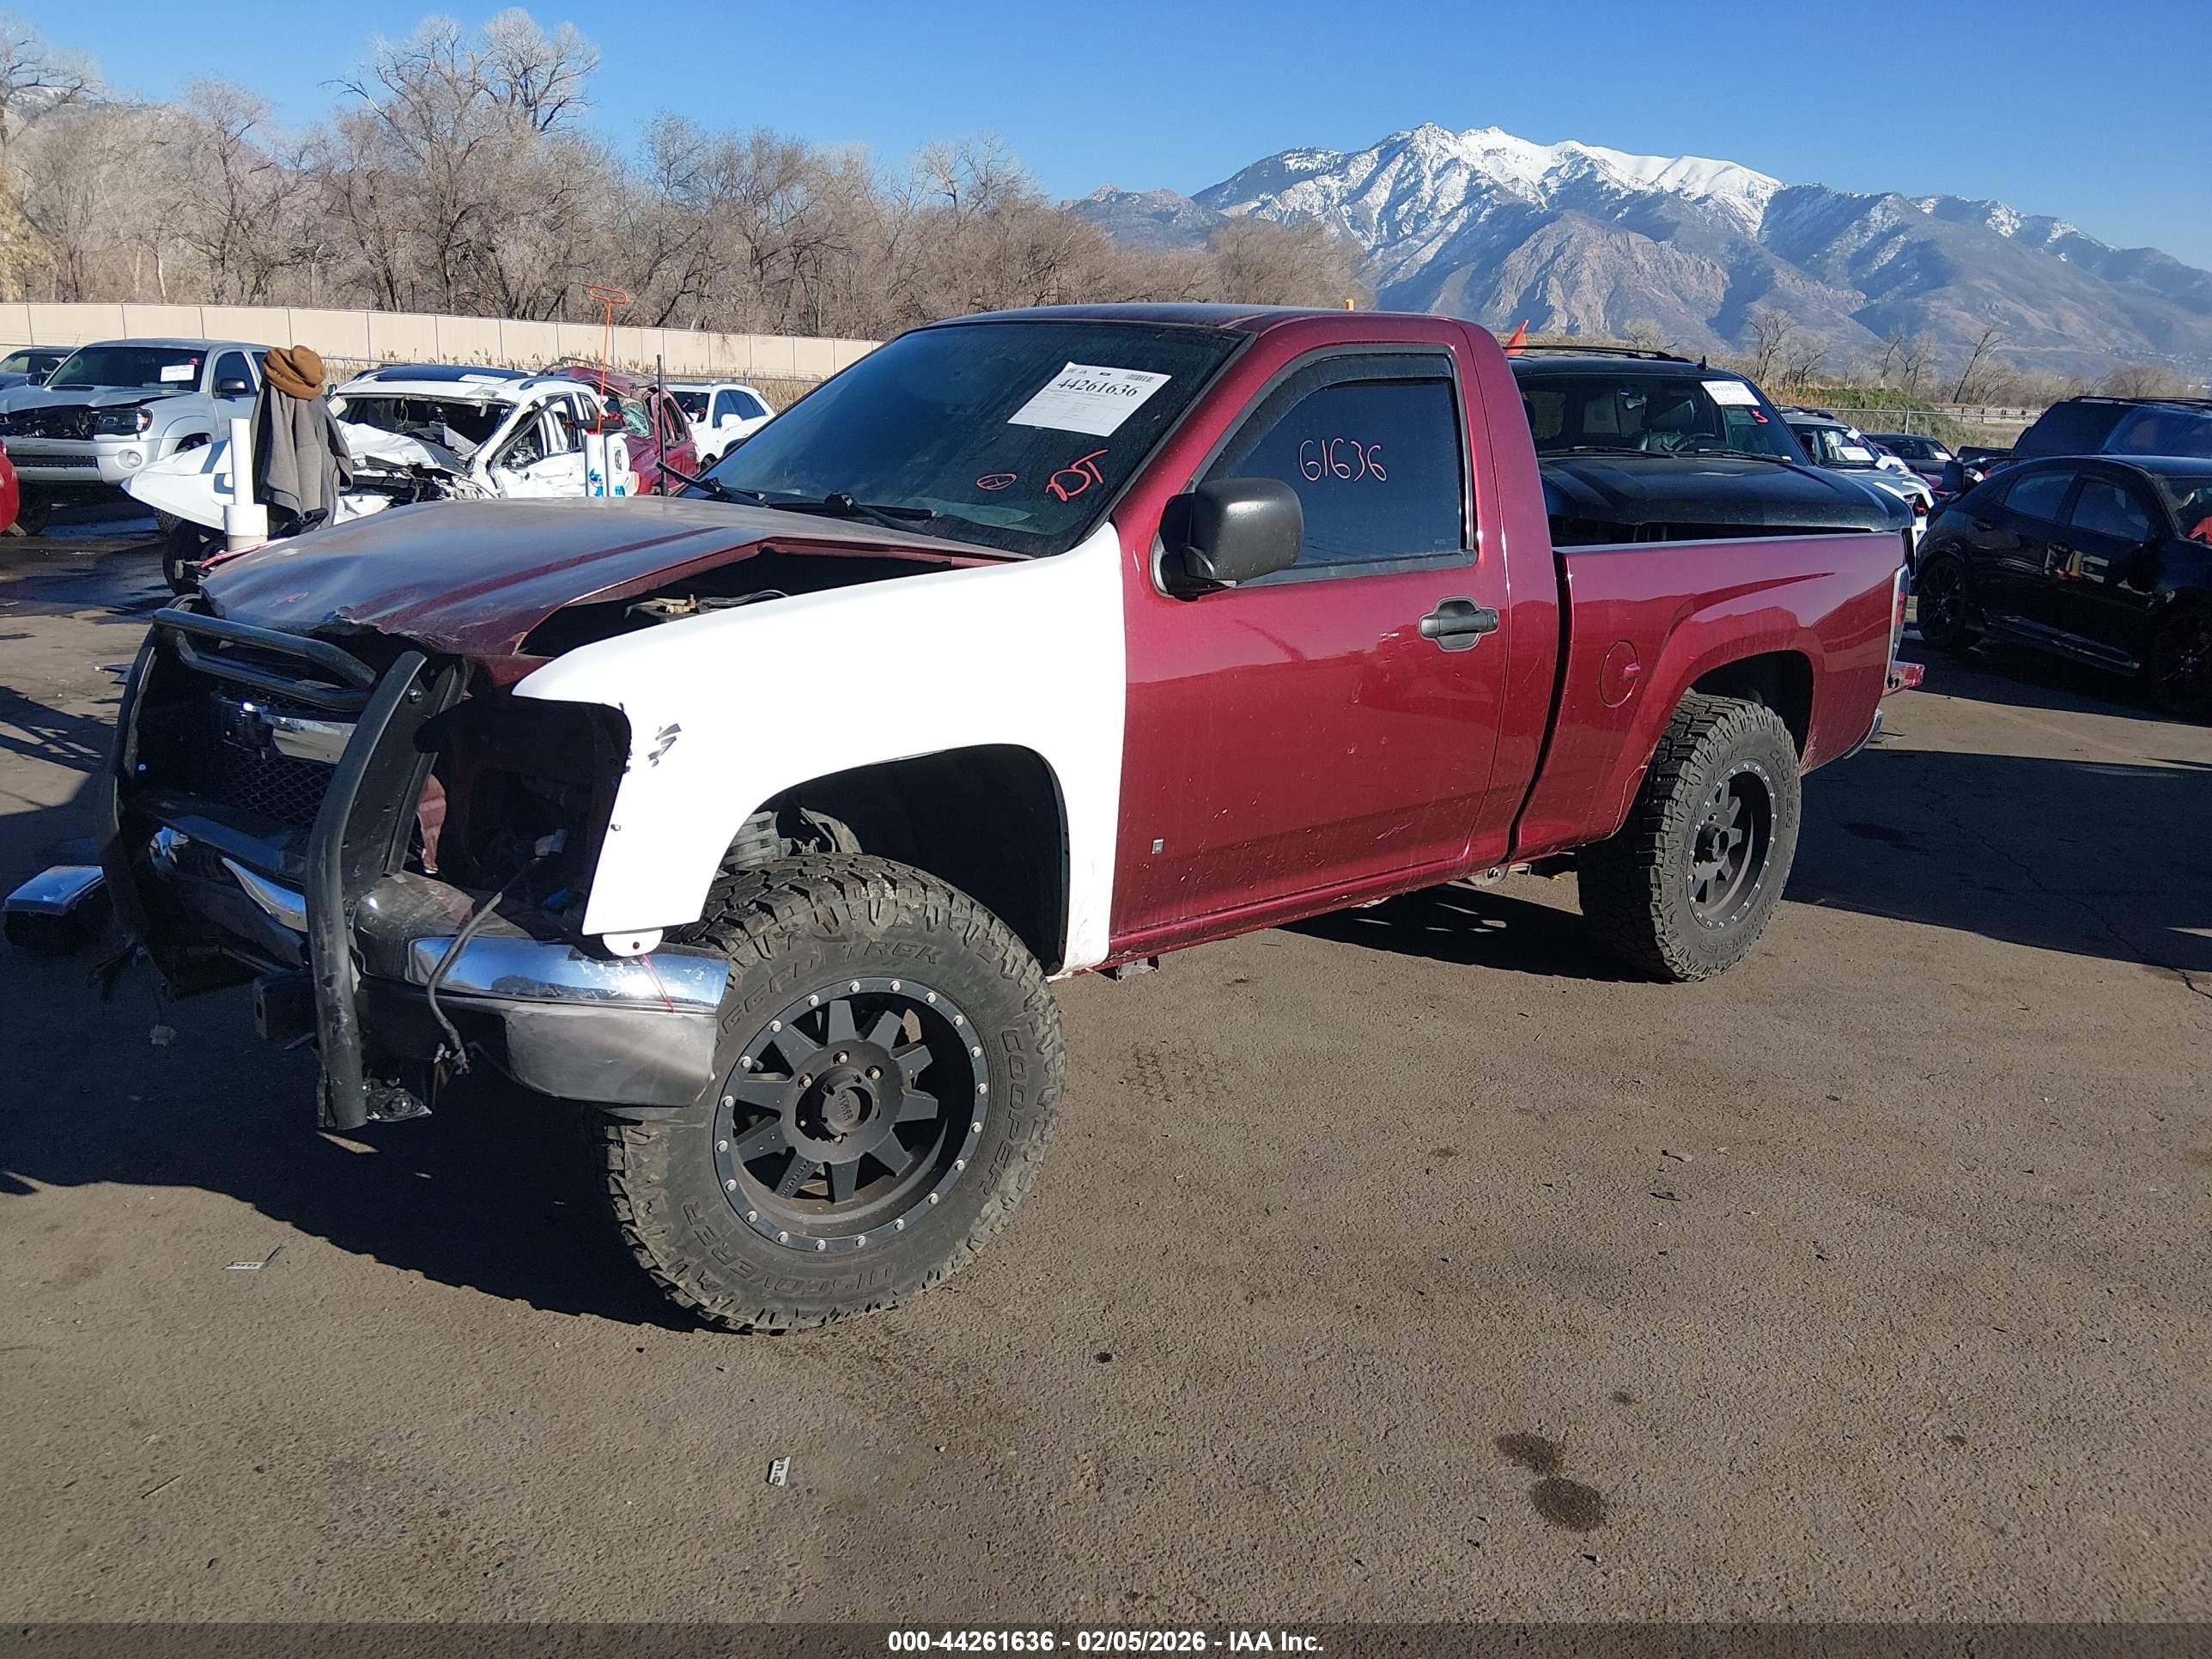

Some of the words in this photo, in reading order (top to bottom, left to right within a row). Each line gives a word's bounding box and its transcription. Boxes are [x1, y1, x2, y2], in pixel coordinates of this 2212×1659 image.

[1057, 378, 1140, 398] 44261636
[1299, 437, 1388, 482] 61636
[1769, 748, 1794, 829] COOPER
[715, 944, 827, 1051] GGED
[841, 939, 945, 966] TREK
[979, 1029, 1028, 1196] COOPER
[683, 1200, 891, 1295] DISCOVERER
